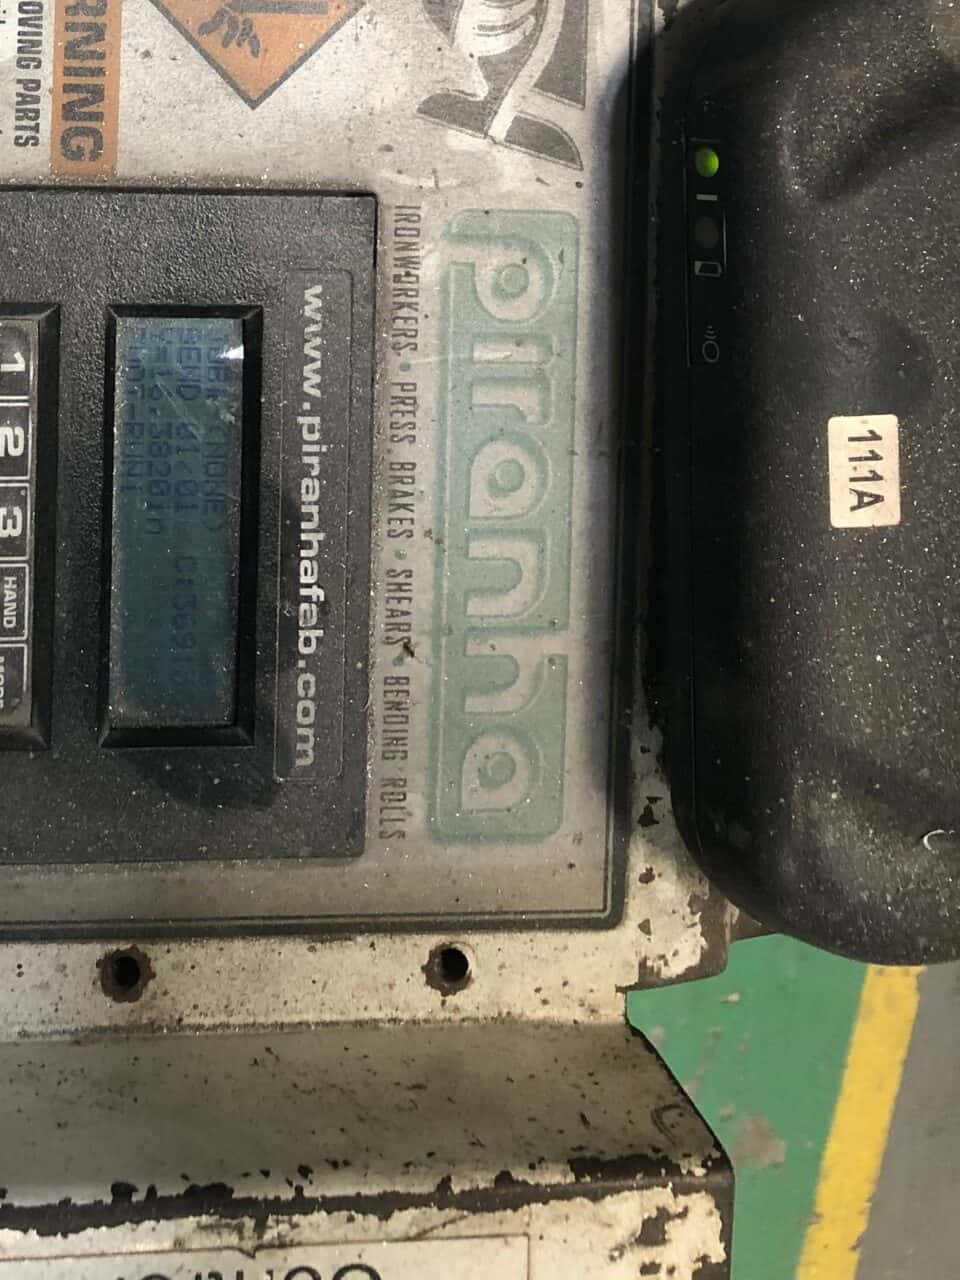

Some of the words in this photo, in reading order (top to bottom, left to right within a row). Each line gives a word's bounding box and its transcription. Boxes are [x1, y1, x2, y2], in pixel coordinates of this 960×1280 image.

[14, 78, 42, 148] PARTS
[391, 204, 420, 352] IRONWORKERS
[0, 351, 25, 373] 1
[389, 381, 417, 444] PRESS
[387, 461, 415, 539] BRAKES
[846, 428, 885, 512] 111A
[295, 284, 327, 767] www.piranhafab.com
[439, 235, 573, 815] piranha
[2, 576, 17, 628] HAND
[384, 568, 412, 646] SHEARS
[381, 675, 410, 760] BENDING
[379, 777, 408, 840] ROLLS
